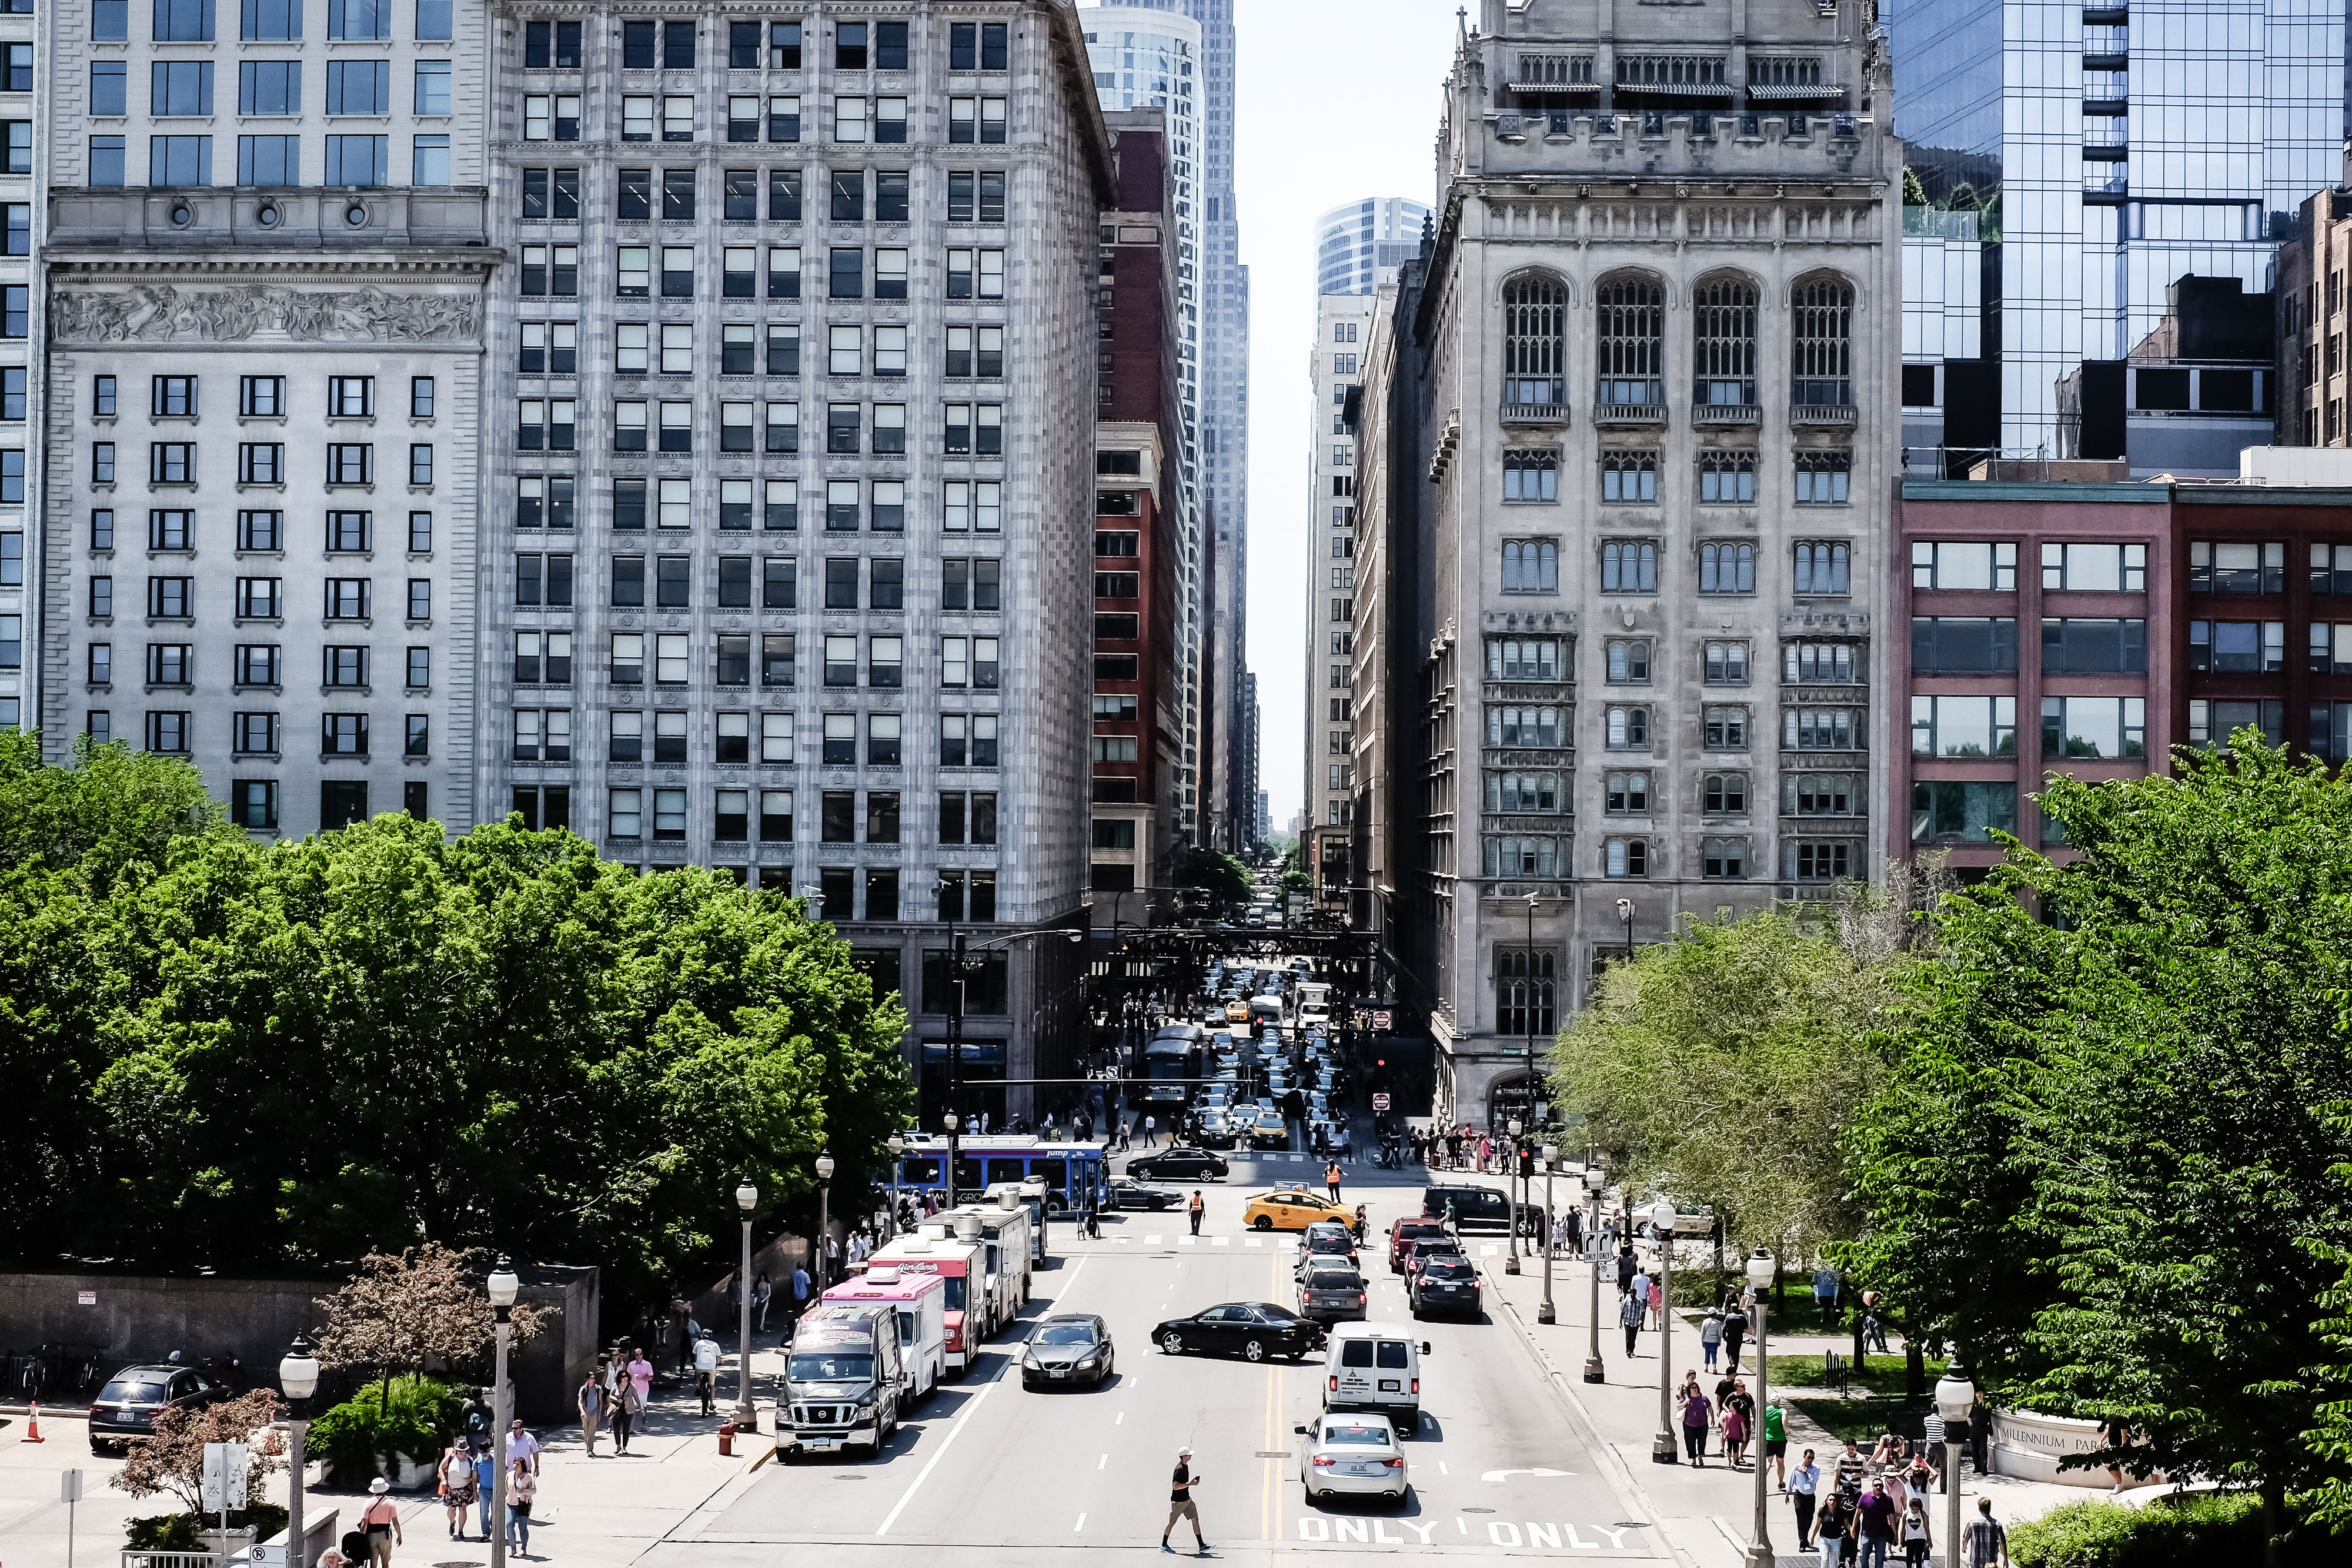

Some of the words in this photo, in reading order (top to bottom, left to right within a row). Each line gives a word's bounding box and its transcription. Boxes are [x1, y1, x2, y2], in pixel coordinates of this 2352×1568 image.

[898, 1262, 938, 1271] Giordano's
[2002, 1427, 2065, 1449] MILLENNIUM
[2076, 1439, 2109, 1451] PARK
[1298, 1517, 1440, 1544] ONLY
[1488, 1521, 1632, 1549] ONLY
